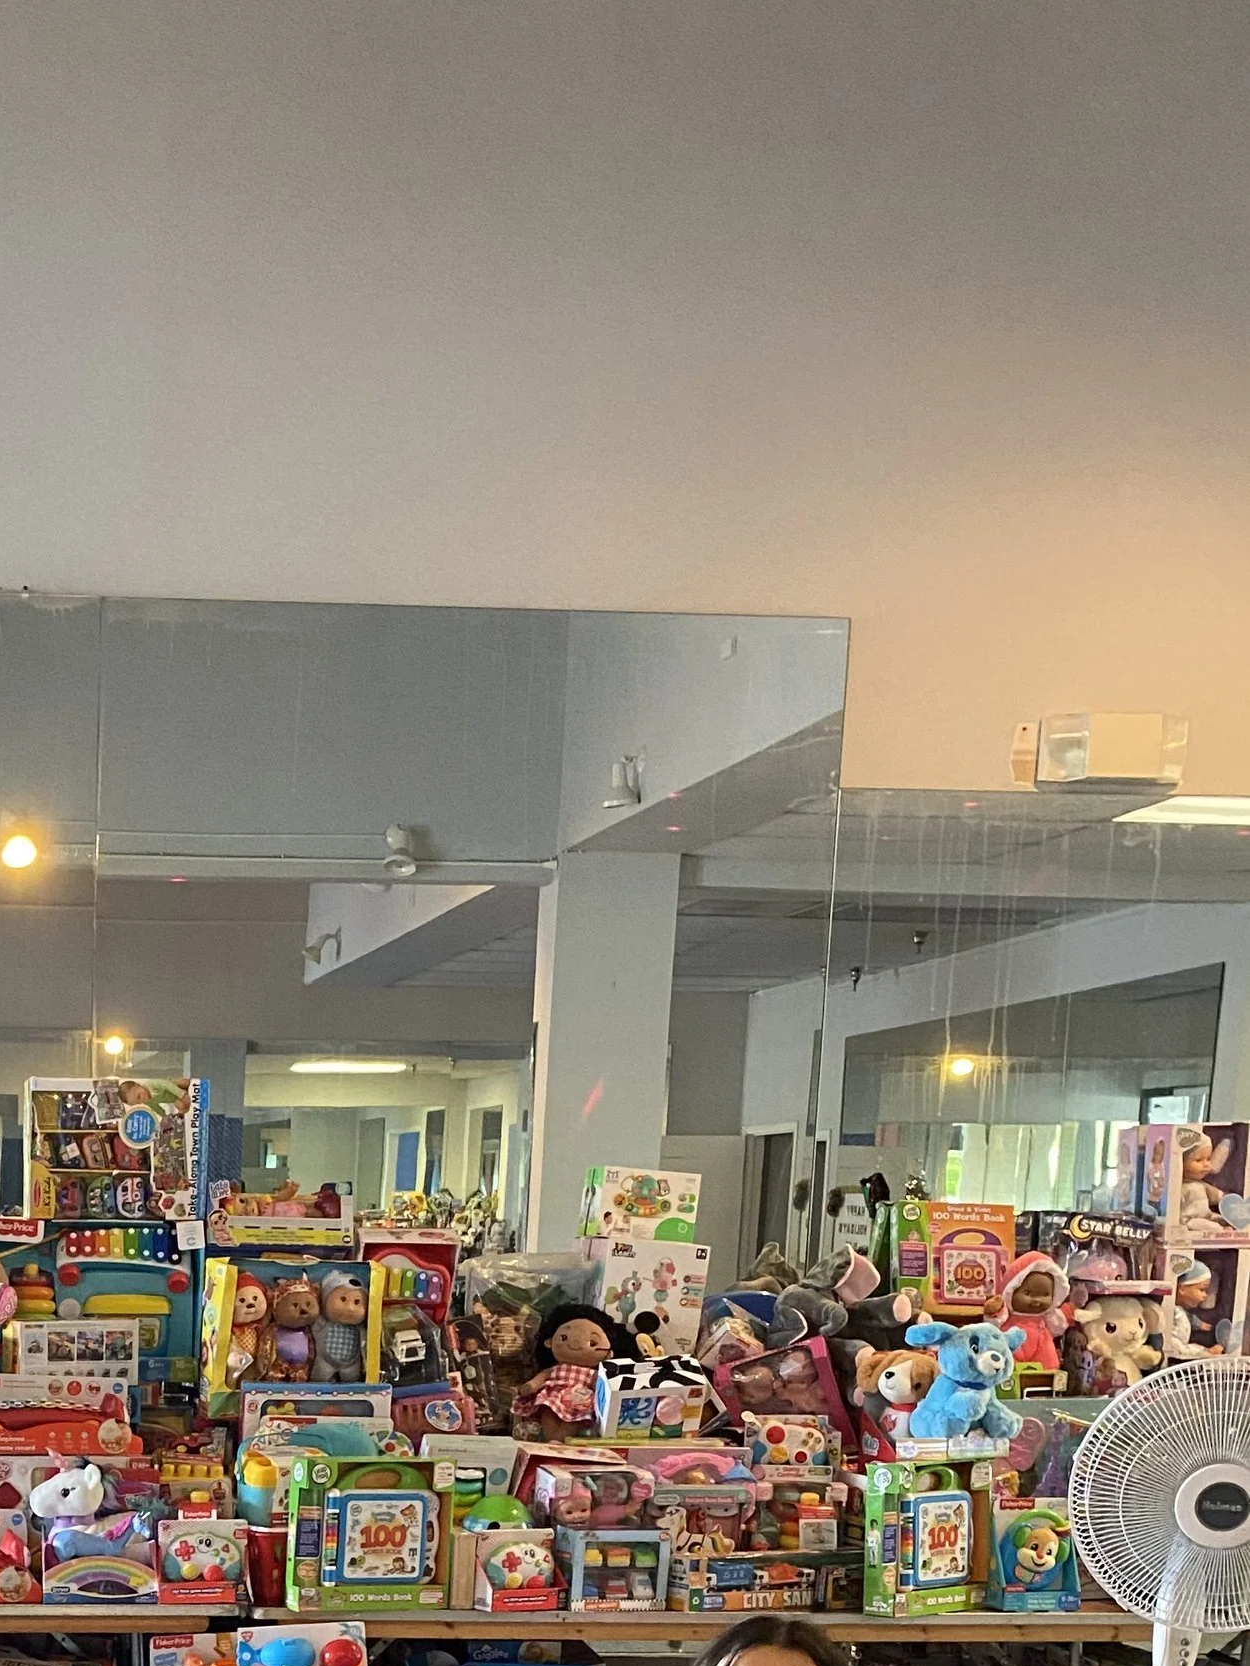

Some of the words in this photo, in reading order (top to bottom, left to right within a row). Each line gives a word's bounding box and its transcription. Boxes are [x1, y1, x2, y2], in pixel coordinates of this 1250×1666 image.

[192, 1083, 201, 1105] Mat
[191, 1107, 201, 1135] Play
[190, 1137, 200, 1163] Town
[189, 1165, 200, 1217] Take-Along
[933, 1211, 950, 1220] 100
[953, 1213, 980, 1222] Words
[984, 1214, 1006, 1223] Book
[1079, 1218, 1112, 1236] STAR
[1114, 1224, 1150, 1239] BELLY
[956, 1266, 985, 1280] 100
[360, 1525, 408, 1548] 100
[926, 1525, 959, 1551] 100
[350, 1593, 365, 1602] 100
[367, 1593, 391, 1602] Words
[393, 1592, 412, 1601] Book
[743, 1591, 775, 1609] CITY
[926, 1596, 937, 1605] 100
